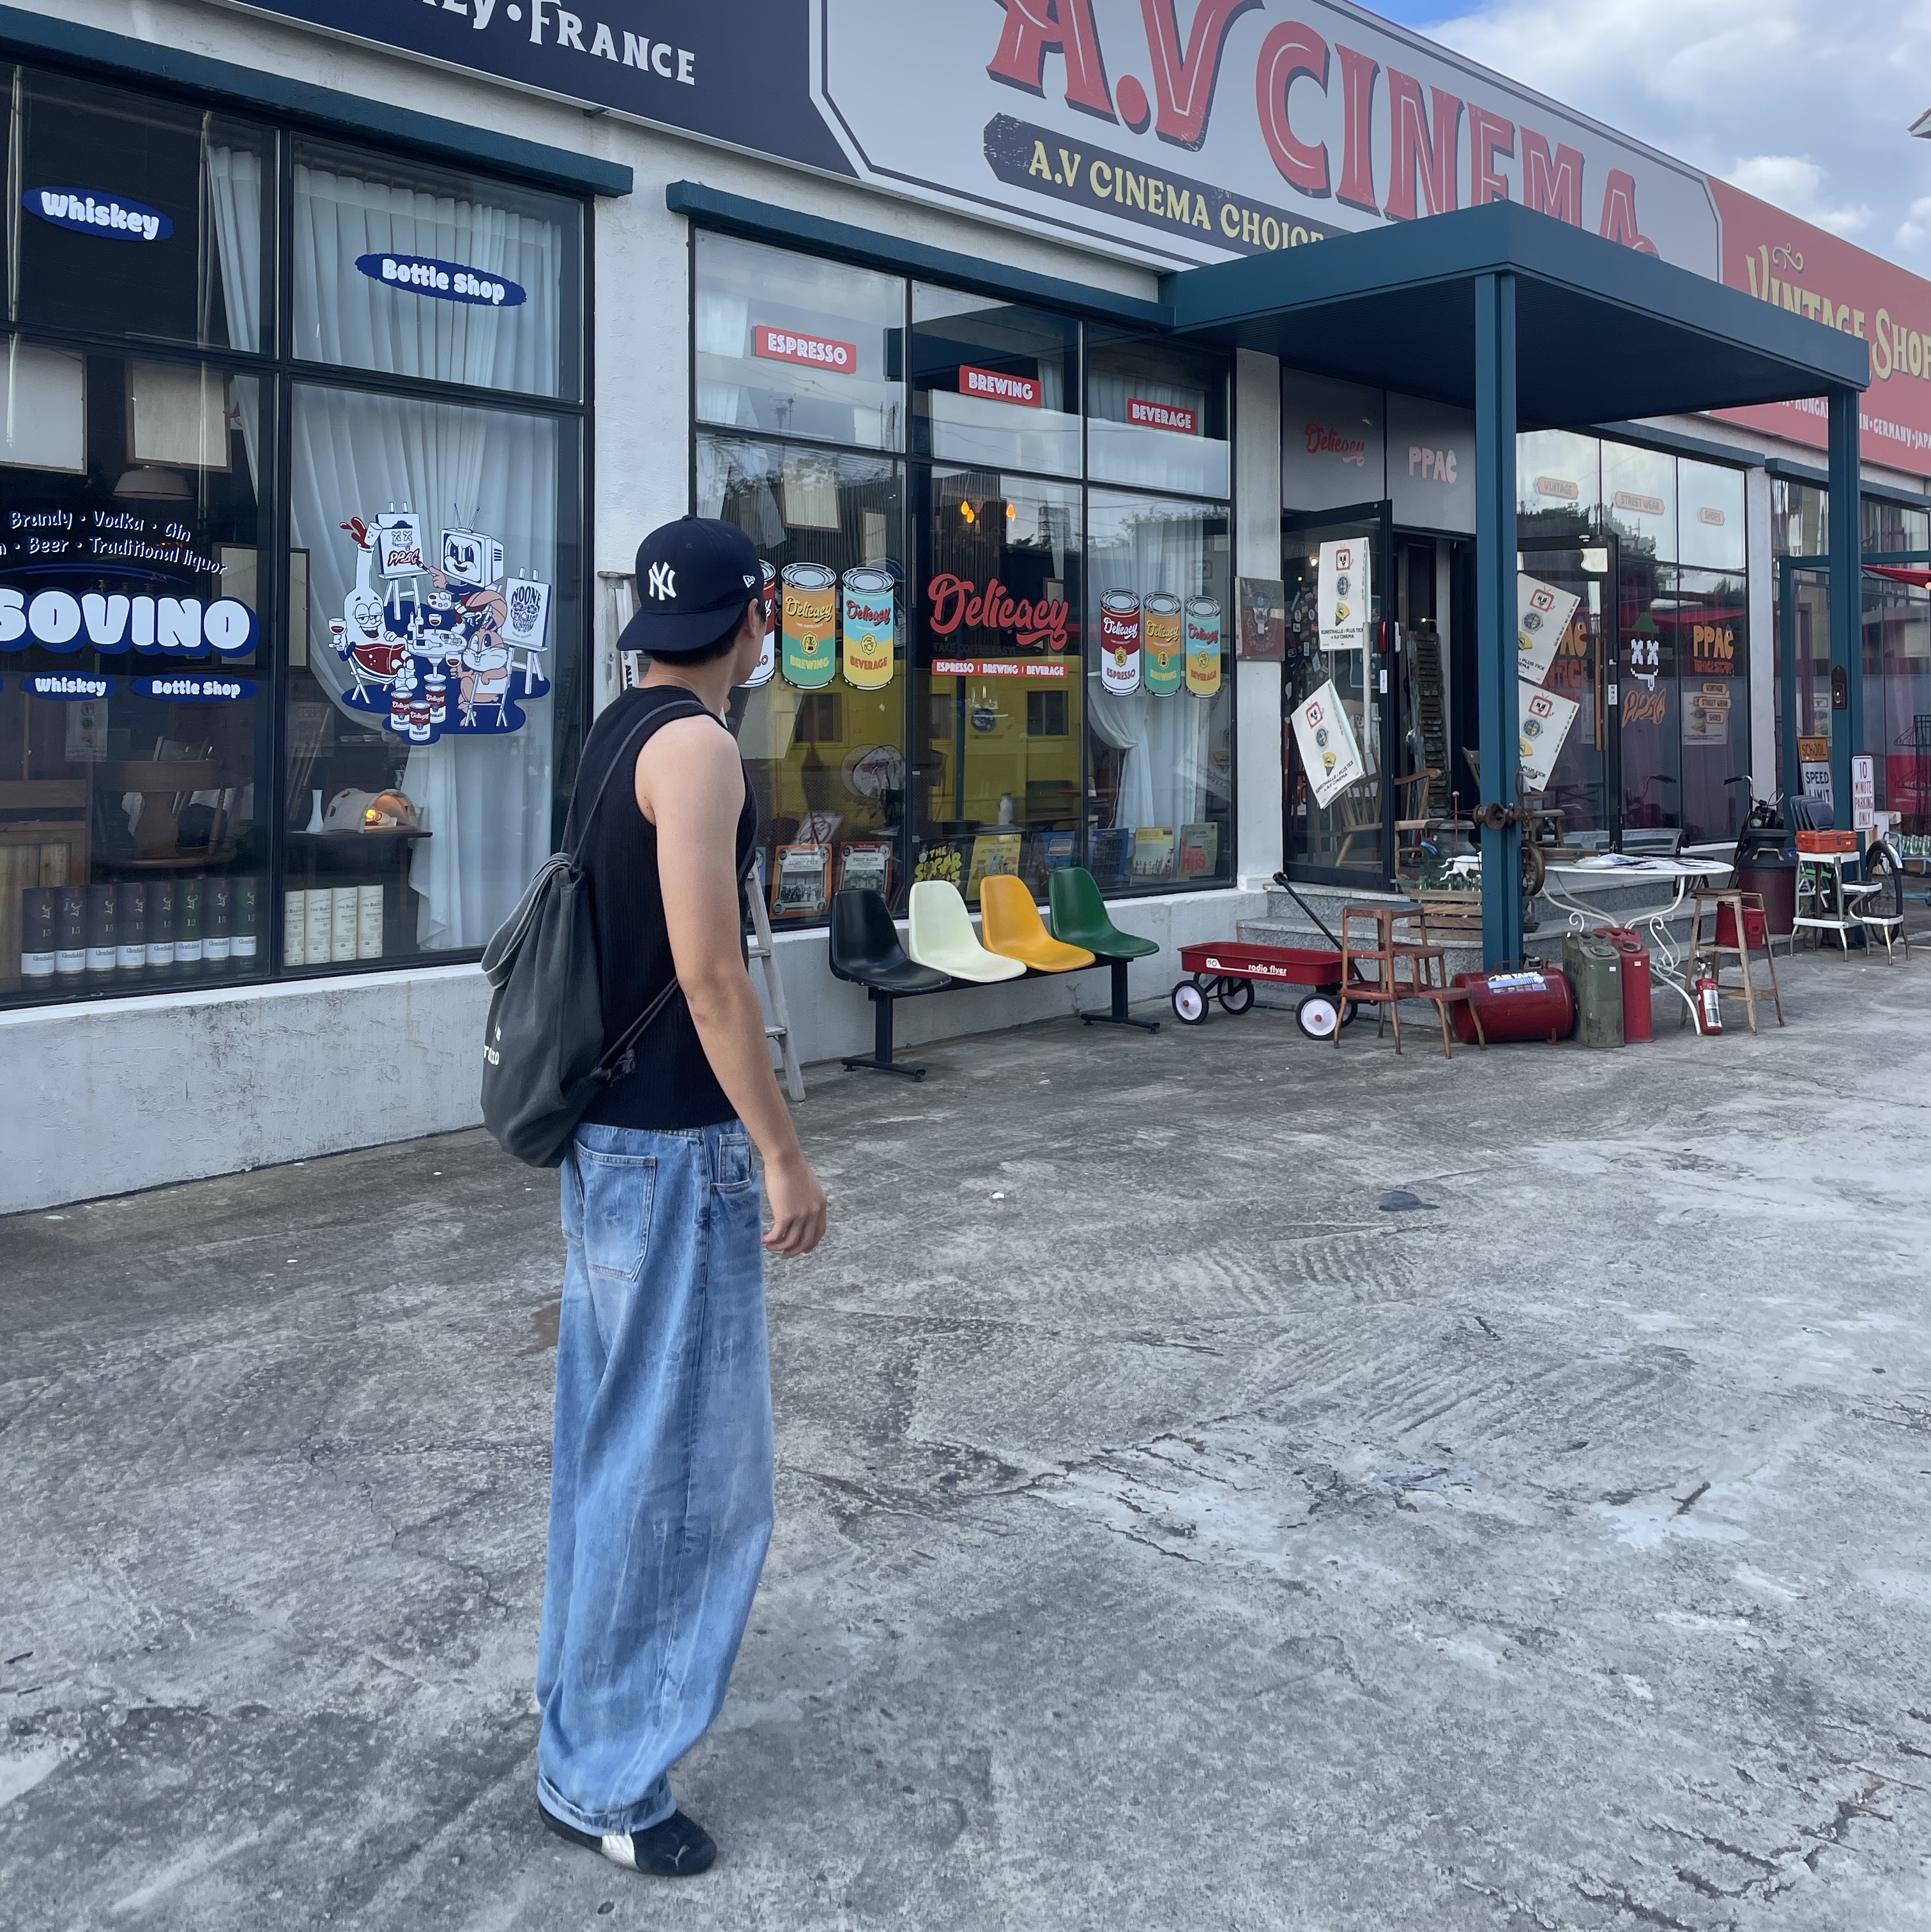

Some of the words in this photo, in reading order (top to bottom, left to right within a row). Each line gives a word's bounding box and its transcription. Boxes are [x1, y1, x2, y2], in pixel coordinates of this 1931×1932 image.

[529, 0, 696, 85] FRANCE
[1255, 21, 1660, 259] CINEMA
[1029, 140, 1081, 187] A.V
[1090, 160, 1211, 231] CINEMA
[41, 191, 160, 240] Whiskey
[382, 258, 449, 291] Bottle
[453, 272, 505, 305] Shop
[767, 332, 847, 365] ESPRESSO
[968, 372, 1034, 400] BREWING
[1132, 402, 1192, 430] BEVERAGE
[1874, 418, 1911, 447] GERMANY
[1305, 421, 1365, 468] Delicacy
[1409, 447, 1457, 484] PPAC
[1544, 480, 1573, 496] VINTAGE
[1621, 494, 1642, 508] STREET
[1644, 499, 1660, 511] WEAR
[10, 509, 72, 530] Brandy
[93, 510, 144, 532] Vodka
[164, 521, 191, 542] Gin
[1705, 510, 1721, 521] SHOES
[29, 537, 68, 554] Beer
[89, 537, 180, 563] Traditional
[183, 549, 228, 575] liquor
[785, 595, 833, 623] Delicacy
[846, 599, 891, 626] Delicacy
[928, 572, 1069, 651] Delicacy
[1104, 617, 1138, 639] Delicacy
[1146, 620, 1179, 641] Delicacy
[1693, 624, 1734, 660] PPAC
[790, 655, 829, 670] BREWING
[850, 656, 888, 670] BEVERAGE
[936, 662, 974, 673] ESPRESSO
[982, 664, 1018, 675] BREWING
[1027, 666, 1064, 676] BEVERAGE
[1106, 668, 1136, 680] ESPRESSO
[34, 676, 107, 696] Whiskey
[152, 680, 200, 695] Bottle
[203, 680, 241, 698] Shop
[1801, 744, 1827, 757] SCHOOL
[1806, 771, 1829, 785] SPEED
[1859, 761, 1868, 779] 10
[1855, 781, 1872, 795] MINUTE
[1855, 796, 1874, 810] PARKING
[1859, 811, 1871, 825] ONLY
[929, 845, 947, 858] THE
[42, 928, 52, 937] 15
[71, 926, 80, 935] 15
[1248, 963, 1267, 972] radio
[1270, 965, 1287, 976] flyer
